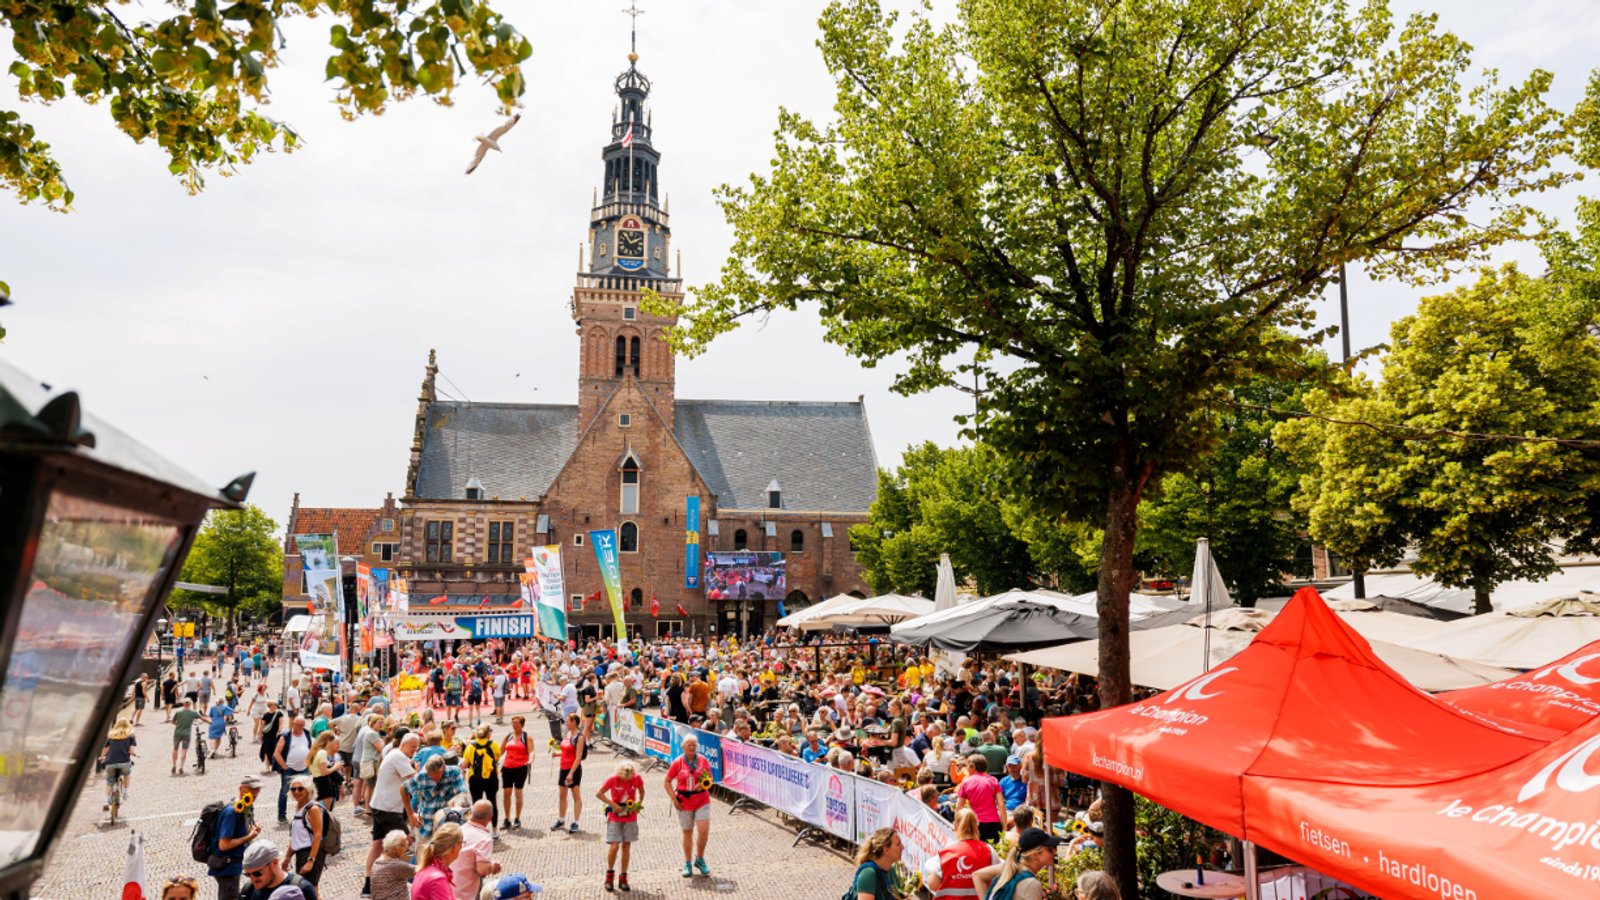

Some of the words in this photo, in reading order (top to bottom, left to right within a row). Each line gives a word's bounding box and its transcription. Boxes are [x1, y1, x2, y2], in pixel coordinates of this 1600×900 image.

[476, 617, 531, 636] FINISH
[1506, 681, 1600, 711] Champio
[1140, 705, 1209, 725] Champion
[1092, 752, 1144, 781] lechampion.nl
[1436, 799, 1473, 818] le
[1299, 821, 1350, 858] fietsen
[1379, 850, 1477, 900] hardlopen
